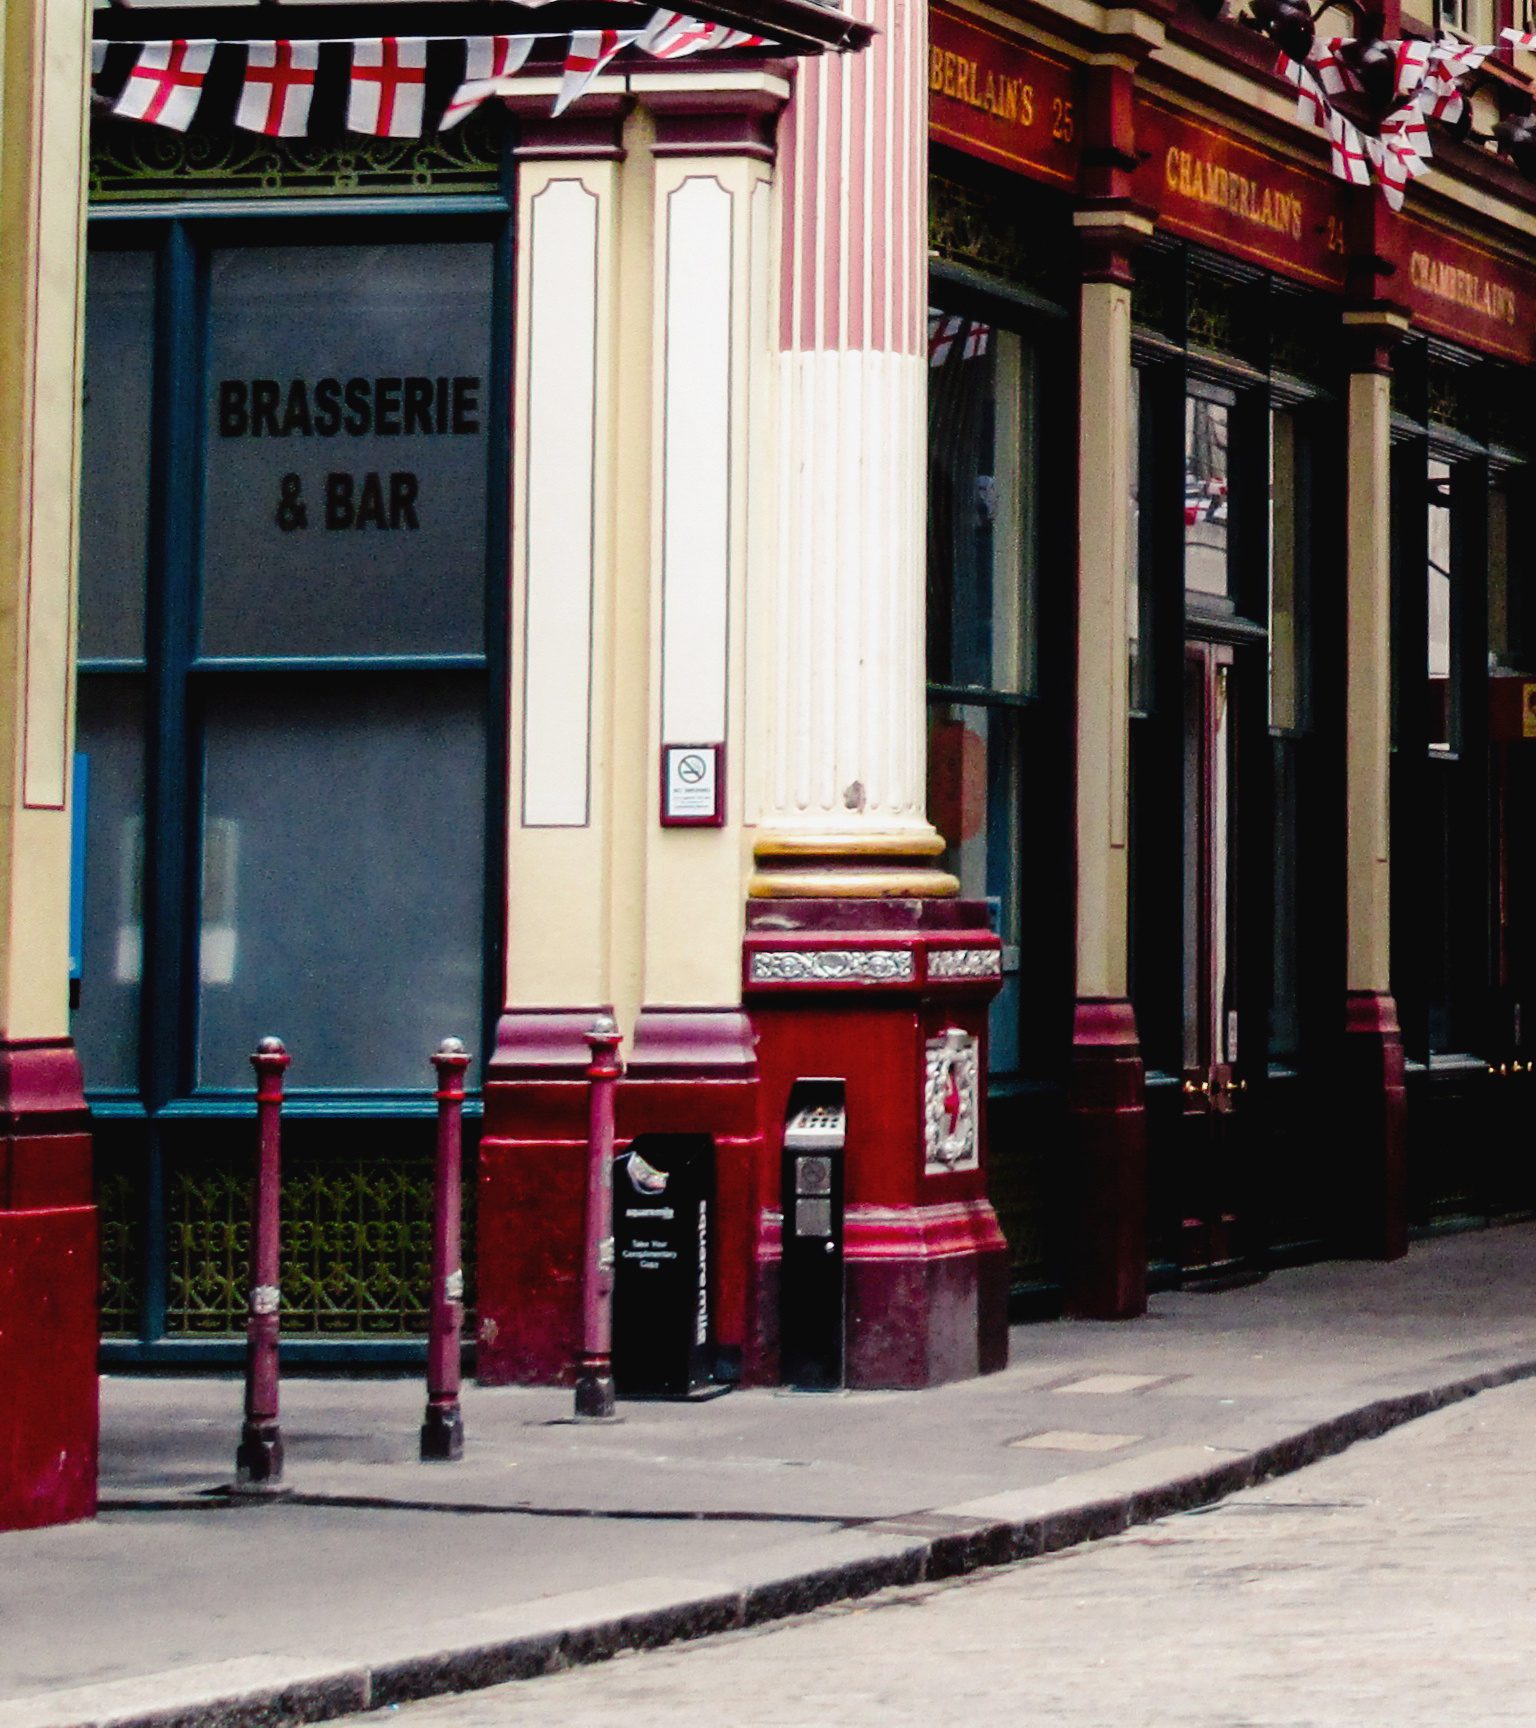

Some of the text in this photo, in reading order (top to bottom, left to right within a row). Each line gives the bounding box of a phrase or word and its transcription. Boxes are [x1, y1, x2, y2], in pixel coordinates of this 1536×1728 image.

[1052, 97, 1074, 142] 25
[1165, 145, 1303, 241] CHAMBERLAIN'S
[217, 376, 481, 438] BRASSERIE
[276, 473, 420, 532] & BAR
